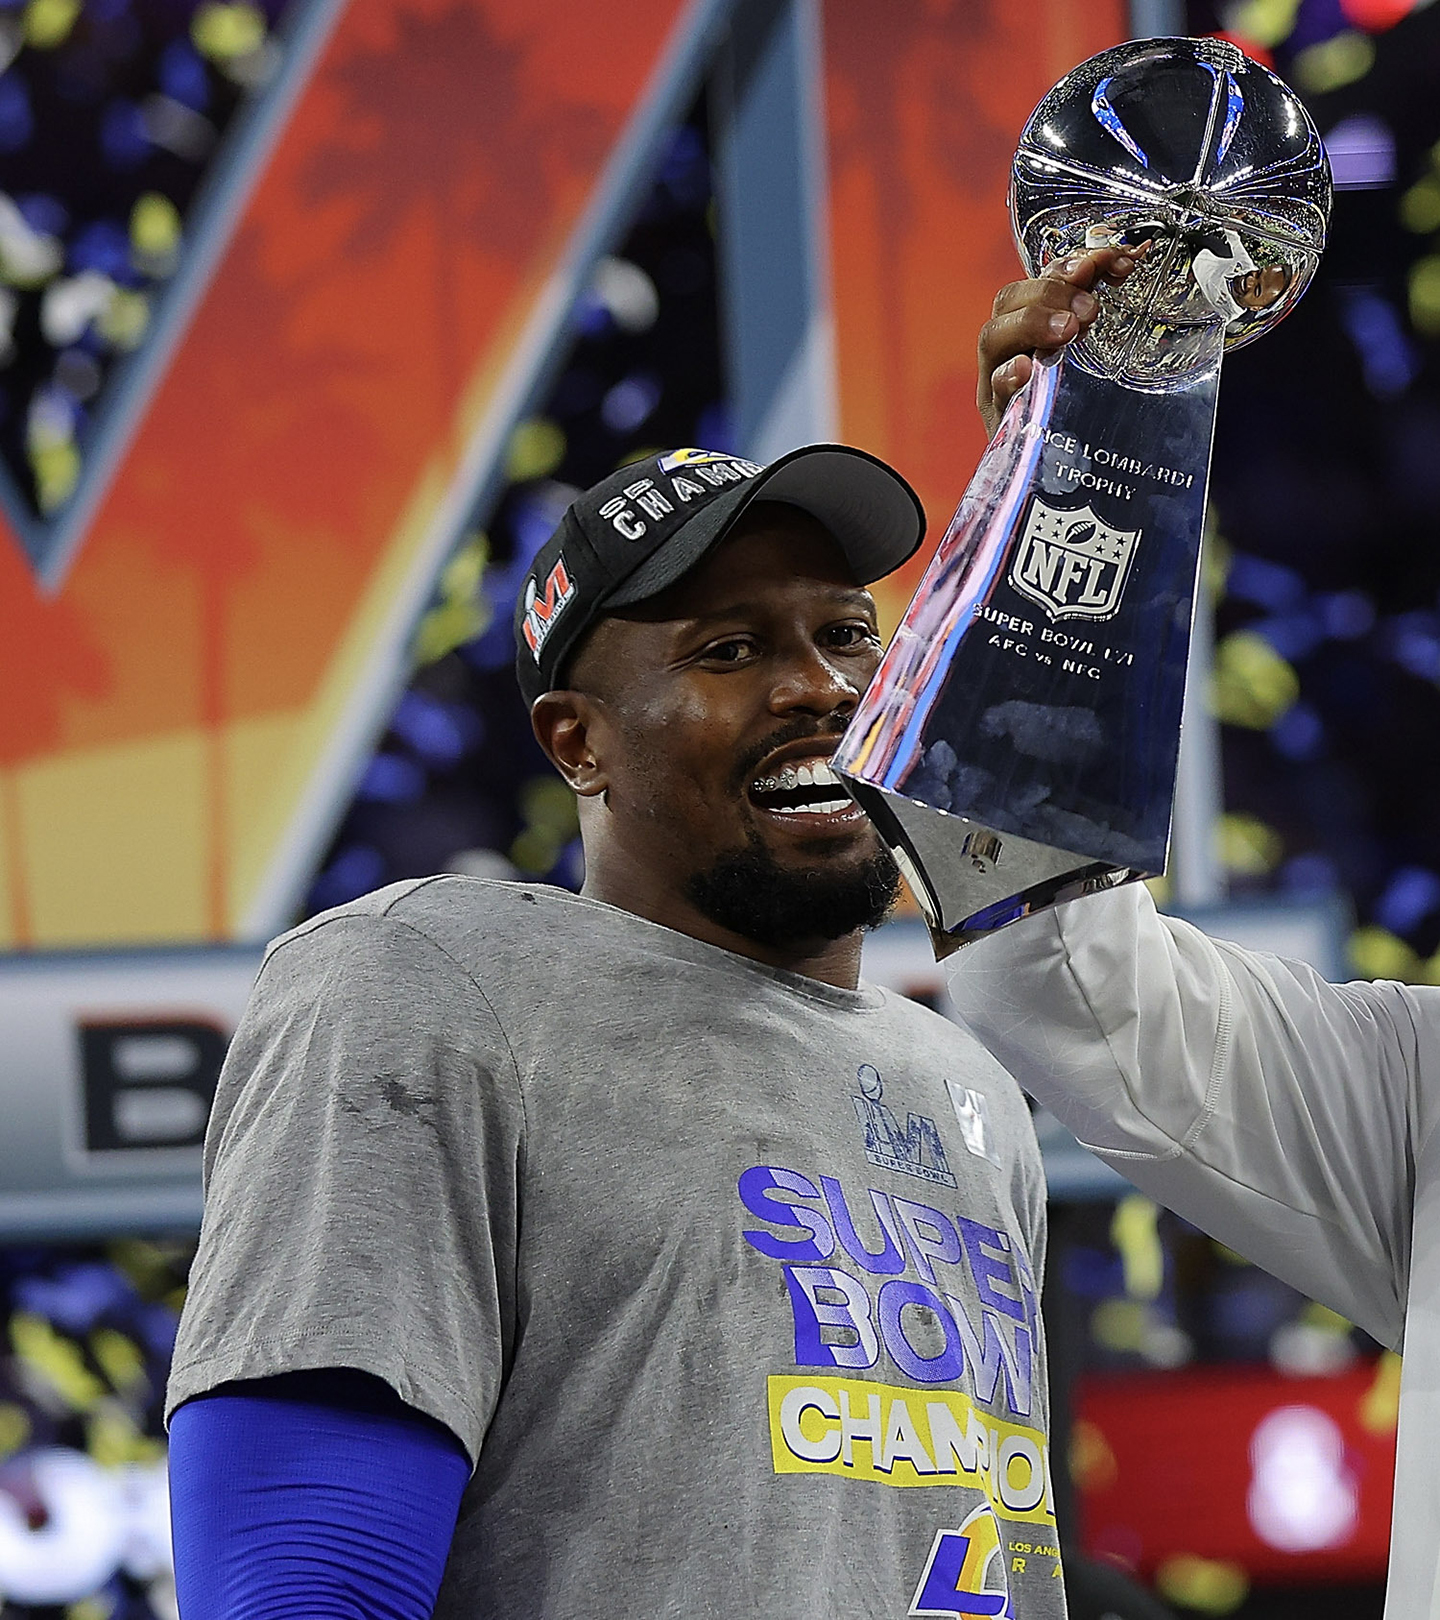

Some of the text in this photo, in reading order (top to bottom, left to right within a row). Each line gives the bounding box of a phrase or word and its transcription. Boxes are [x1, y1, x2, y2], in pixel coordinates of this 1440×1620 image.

[1019, 418, 1194, 489] ANCE LOMBARDI
[1055, 460, 1137, 500] TROPHY
[1023, 540, 1109, 605] NFL
[972, 602, 1034, 636] SUPER
[1040, 627, 1096, 656] BOWL
[988, 634, 1102, 680] AFC vs NFC
[874, 1154, 950, 1184] SUPER BOWL
[780, 1386, 1055, 1516] CHAMPIO
[1008, 1541, 1032, 1554] LOS
